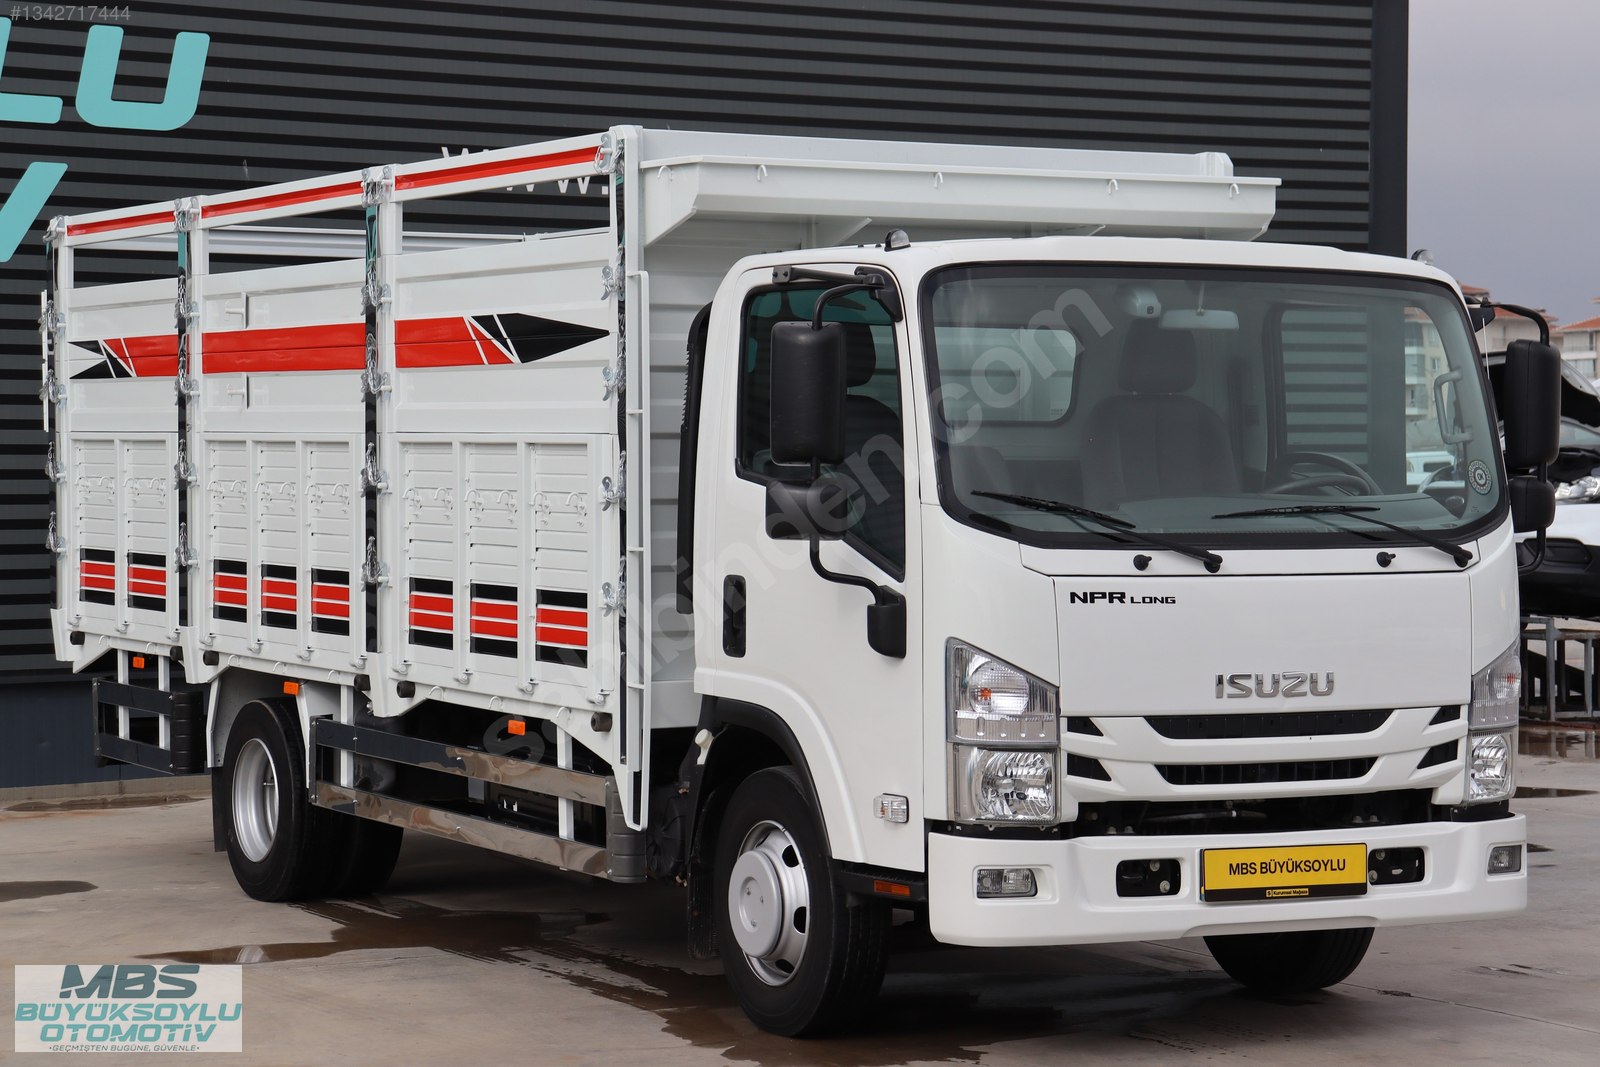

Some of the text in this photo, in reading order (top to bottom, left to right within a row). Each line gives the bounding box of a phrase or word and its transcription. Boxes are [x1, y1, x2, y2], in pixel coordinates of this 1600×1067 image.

[1070, 592, 1176, 604] NPR LONG
[1215, 671, 1335, 699] ISUZU
[1229, 858, 1345, 875] MBS BÜYÜKSOYLU
